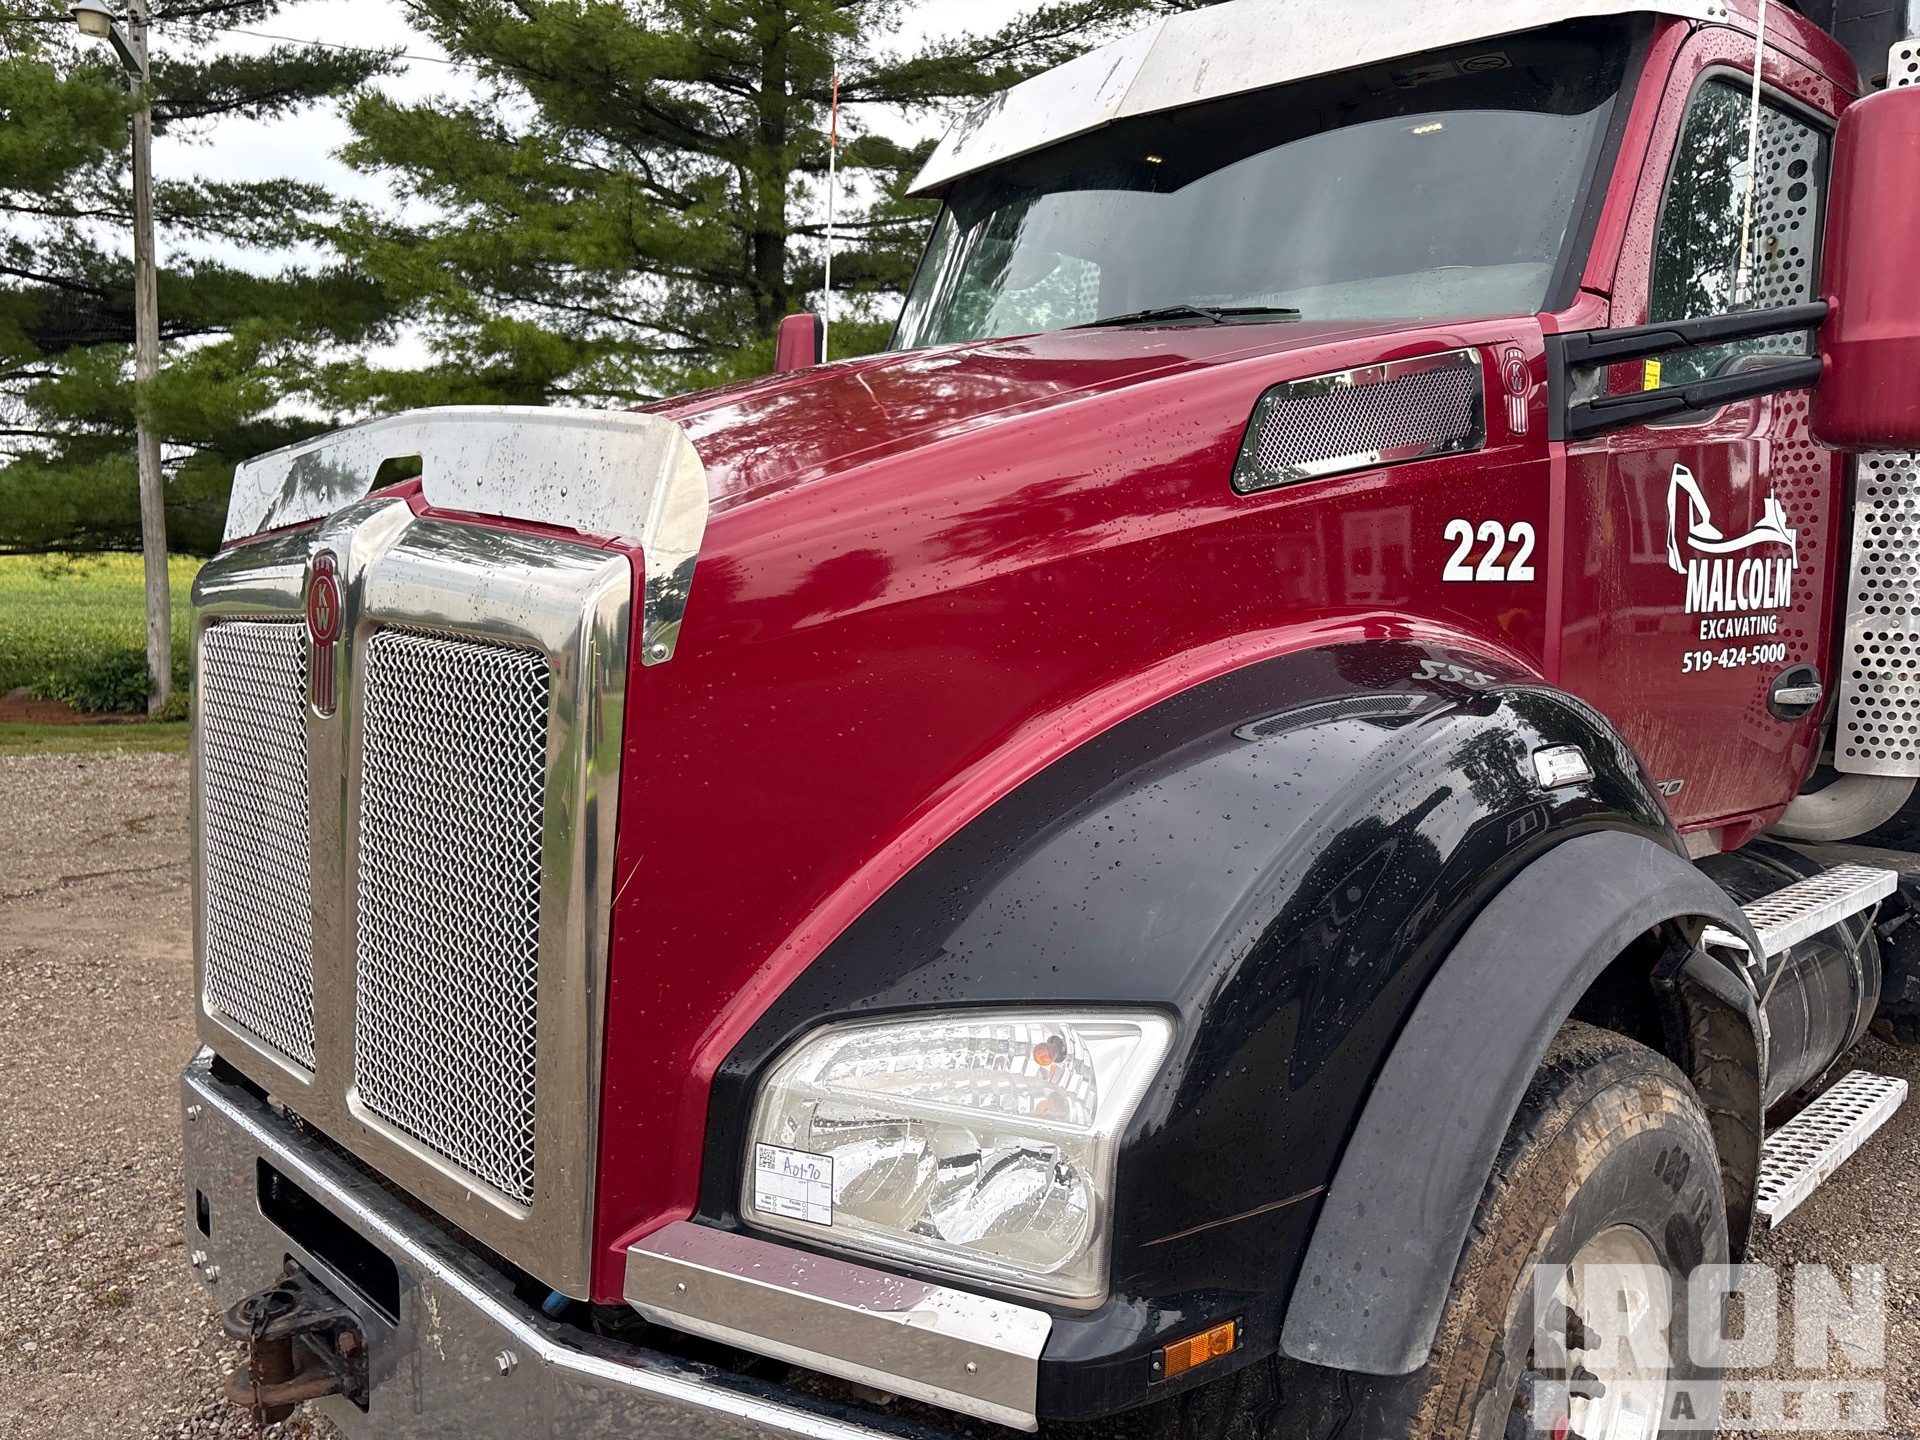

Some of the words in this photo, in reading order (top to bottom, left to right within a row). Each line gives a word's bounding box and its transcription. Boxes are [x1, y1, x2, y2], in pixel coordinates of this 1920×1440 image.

[1442, 518, 1535, 582] 222
[1684, 557, 1793, 614] MALCOLM
[1699, 614, 1778, 640] EXCAVATING
[1681, 642, 1787, 673] 519-424-5000
